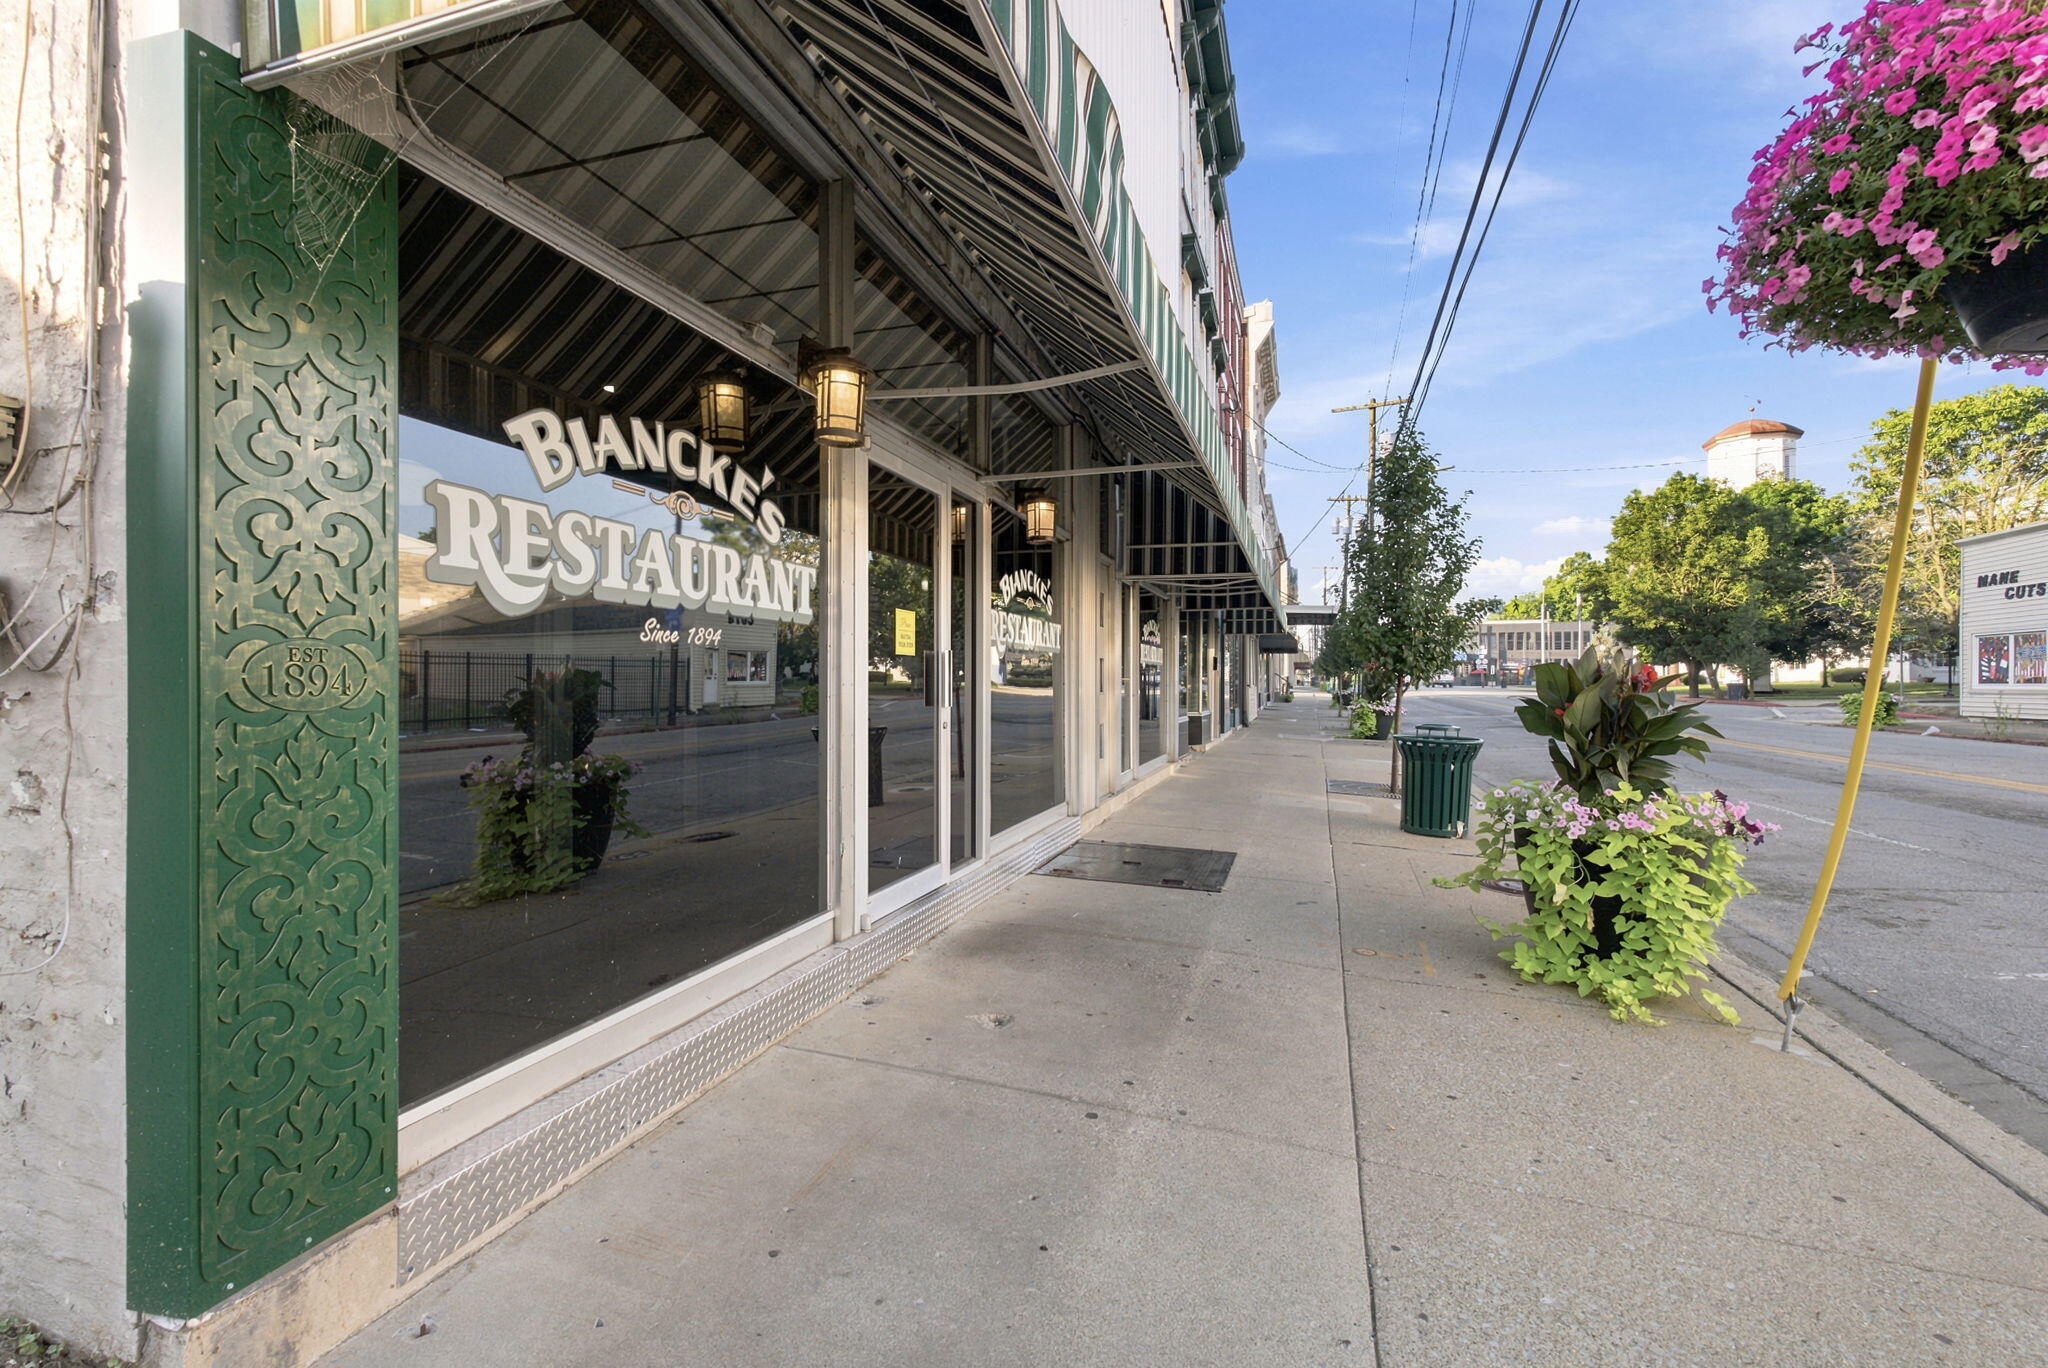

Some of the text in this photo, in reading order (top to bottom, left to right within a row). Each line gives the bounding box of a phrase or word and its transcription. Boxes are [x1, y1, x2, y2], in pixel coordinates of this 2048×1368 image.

[502, 408, 784, 546] BIANCKE'S
[424, 479, 818, 624] RESTAURANT
[1000, 568, 1054, 616] BIANCKE'S
[1977, 570, 2020, 588] MANE
[2004, 582, 2047, 600] CUTS
[640, 617, 723, 646] Since 1894
[991, 608, 1062, 660] RESTAURANT
[287, 647, 329, 663] EST
[261, 661, 352, 698] 1894
